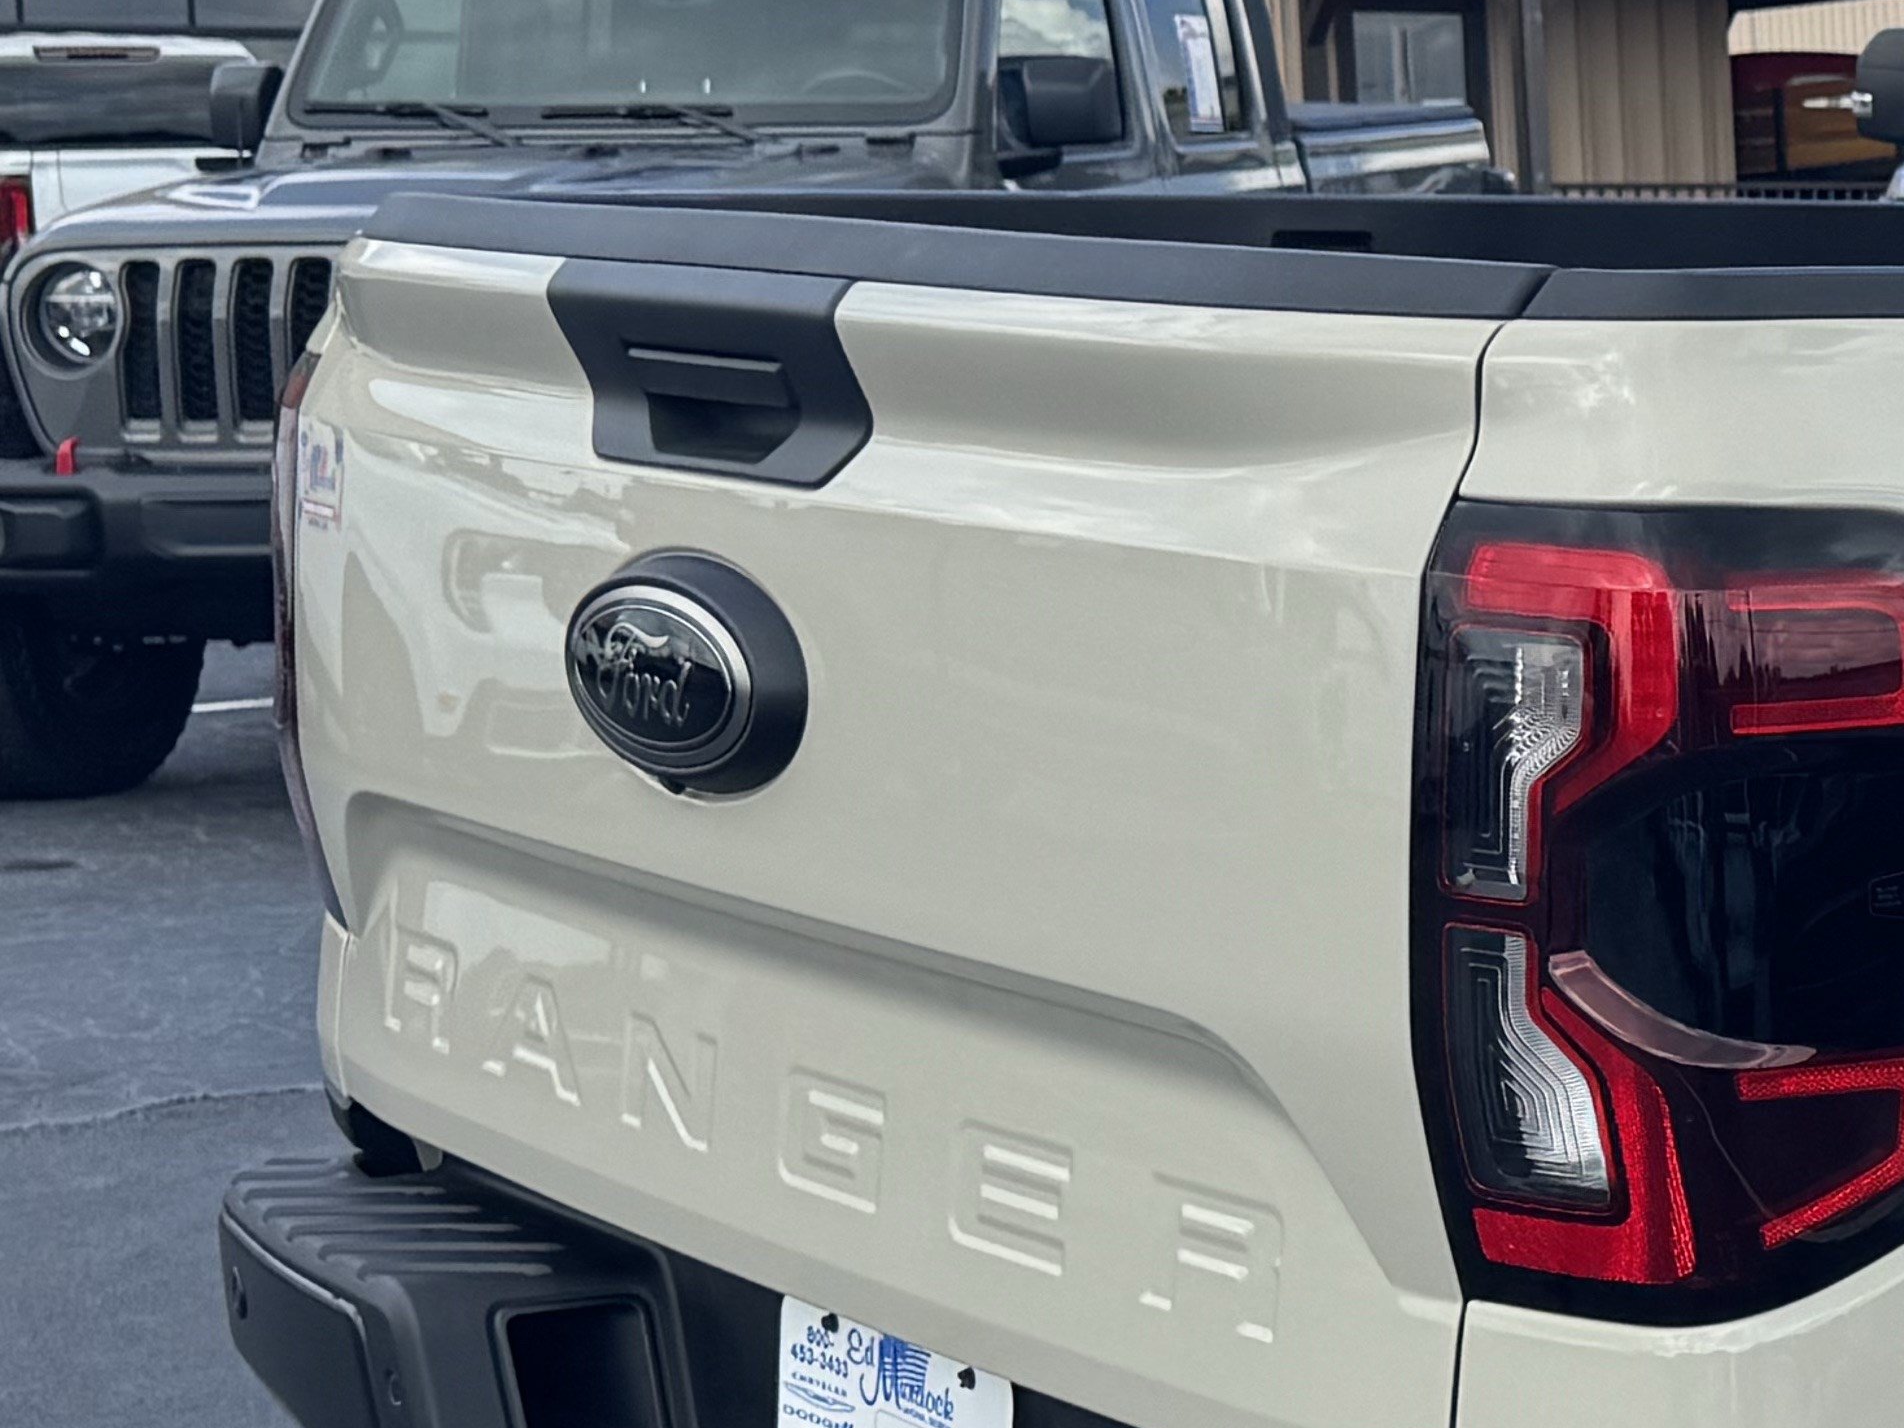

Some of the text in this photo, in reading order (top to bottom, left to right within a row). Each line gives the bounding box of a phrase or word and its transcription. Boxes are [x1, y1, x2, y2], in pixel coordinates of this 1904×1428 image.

[597, 622, 690, 728] Ford
[384, 917, 1283, 1343] RANGER
[847, 1328, 876, 1368] Ed
